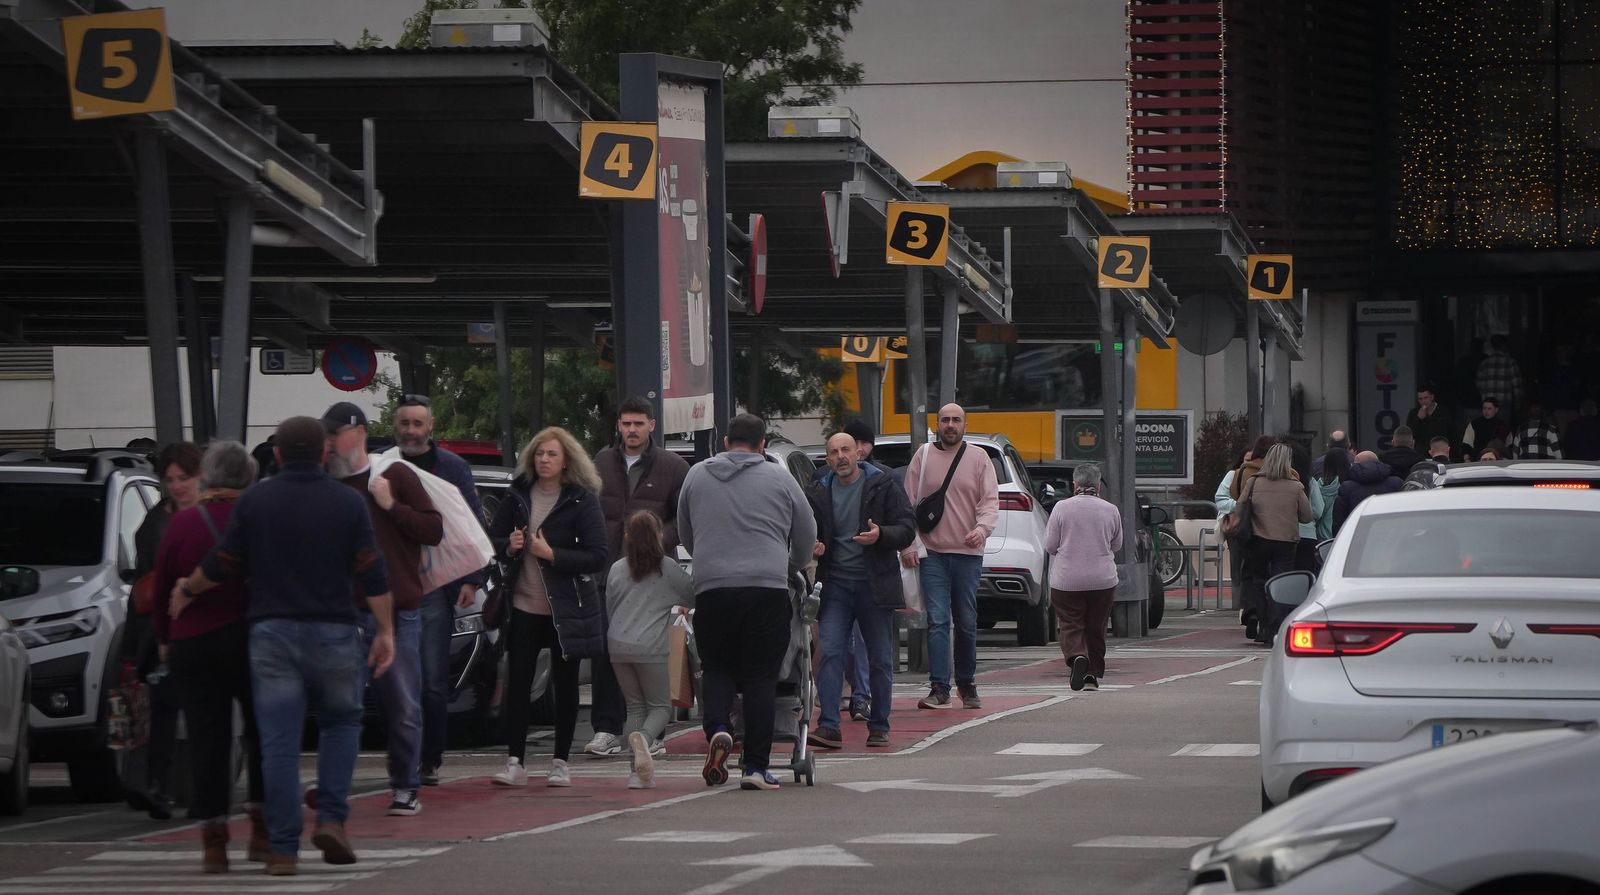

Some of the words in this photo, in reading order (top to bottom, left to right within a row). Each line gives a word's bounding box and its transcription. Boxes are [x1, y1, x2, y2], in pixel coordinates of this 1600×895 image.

[102, 40, 138, 89] 5
[604, 143, 633, 178] 4
[906, 219, 928, 249] 3
[1115, 249, 1133, 275] 2
[1263, 266, 1275, 288] 1
[1135, 424, 1175, 432] ADONA
[1451, 655, 1553, 664] TALISMAN
